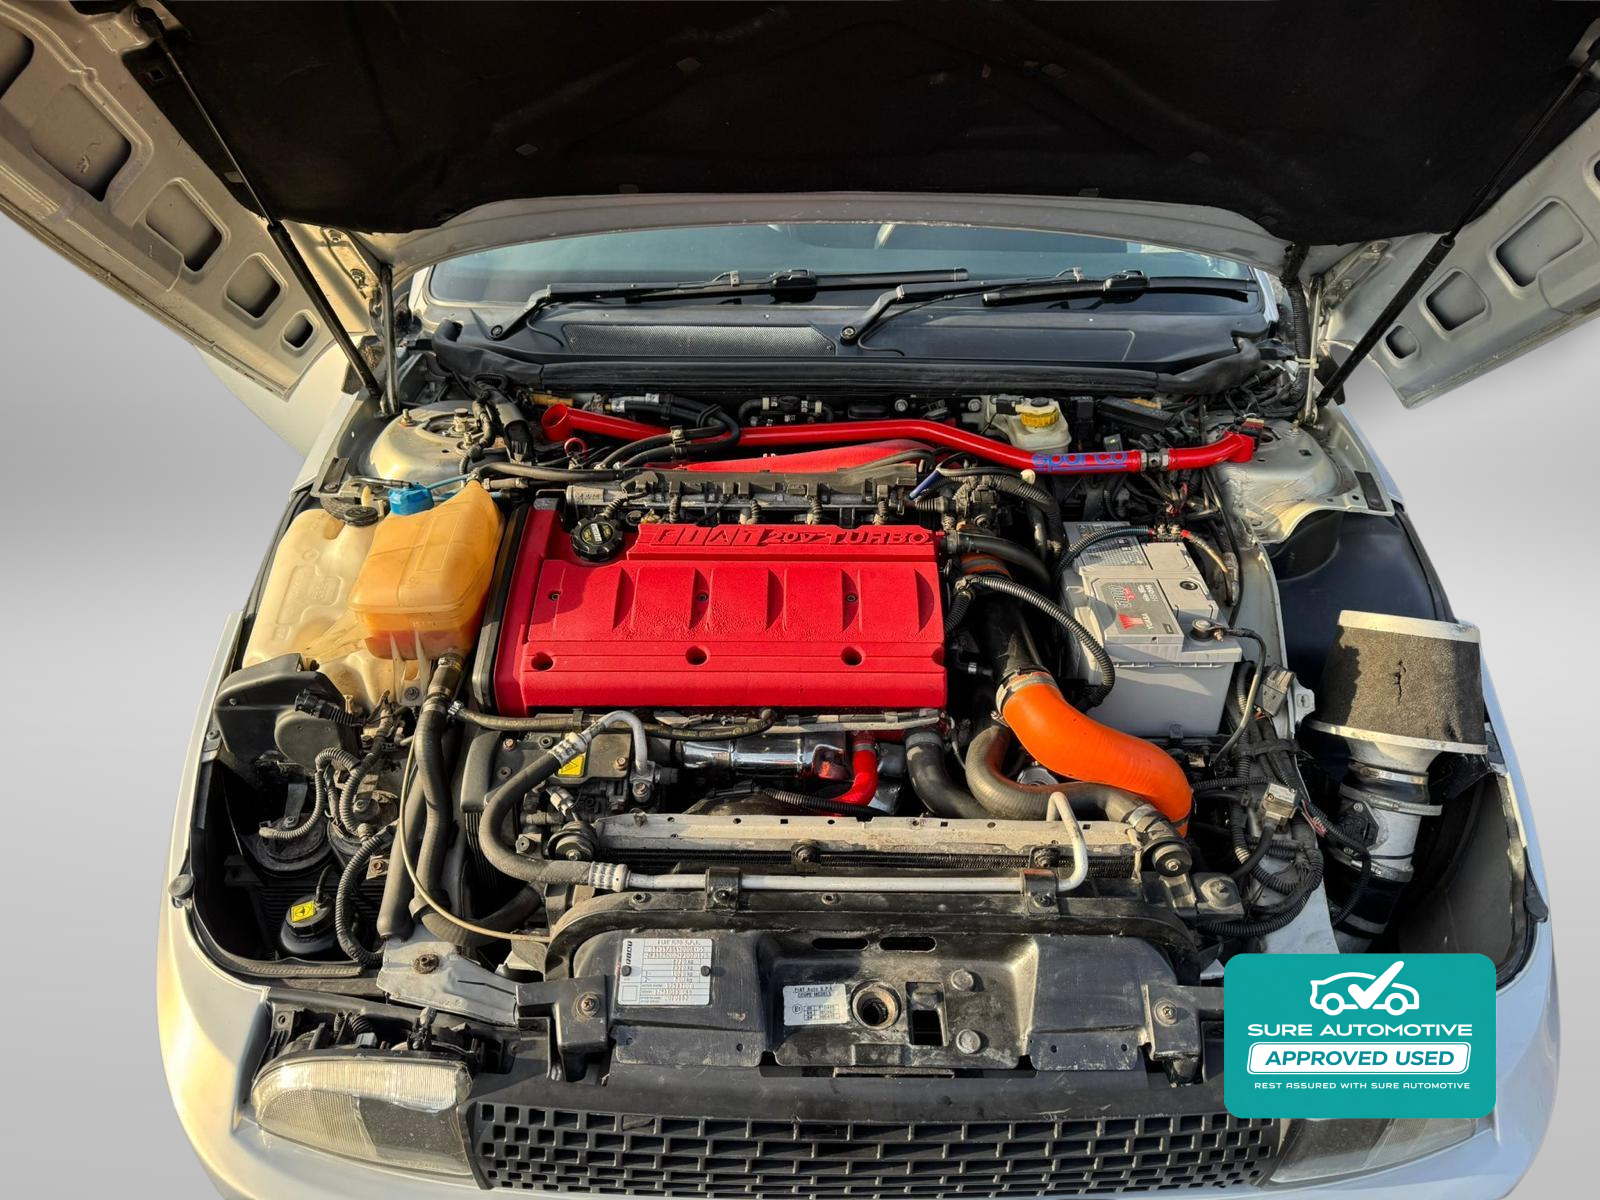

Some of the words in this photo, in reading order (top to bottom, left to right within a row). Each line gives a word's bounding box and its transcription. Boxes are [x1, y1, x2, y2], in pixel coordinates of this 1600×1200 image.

[1032, 452, 1127, 472] sparco
[654, 528, 754, 544] FIAT
[827, 531, 930, 545] TURBO
